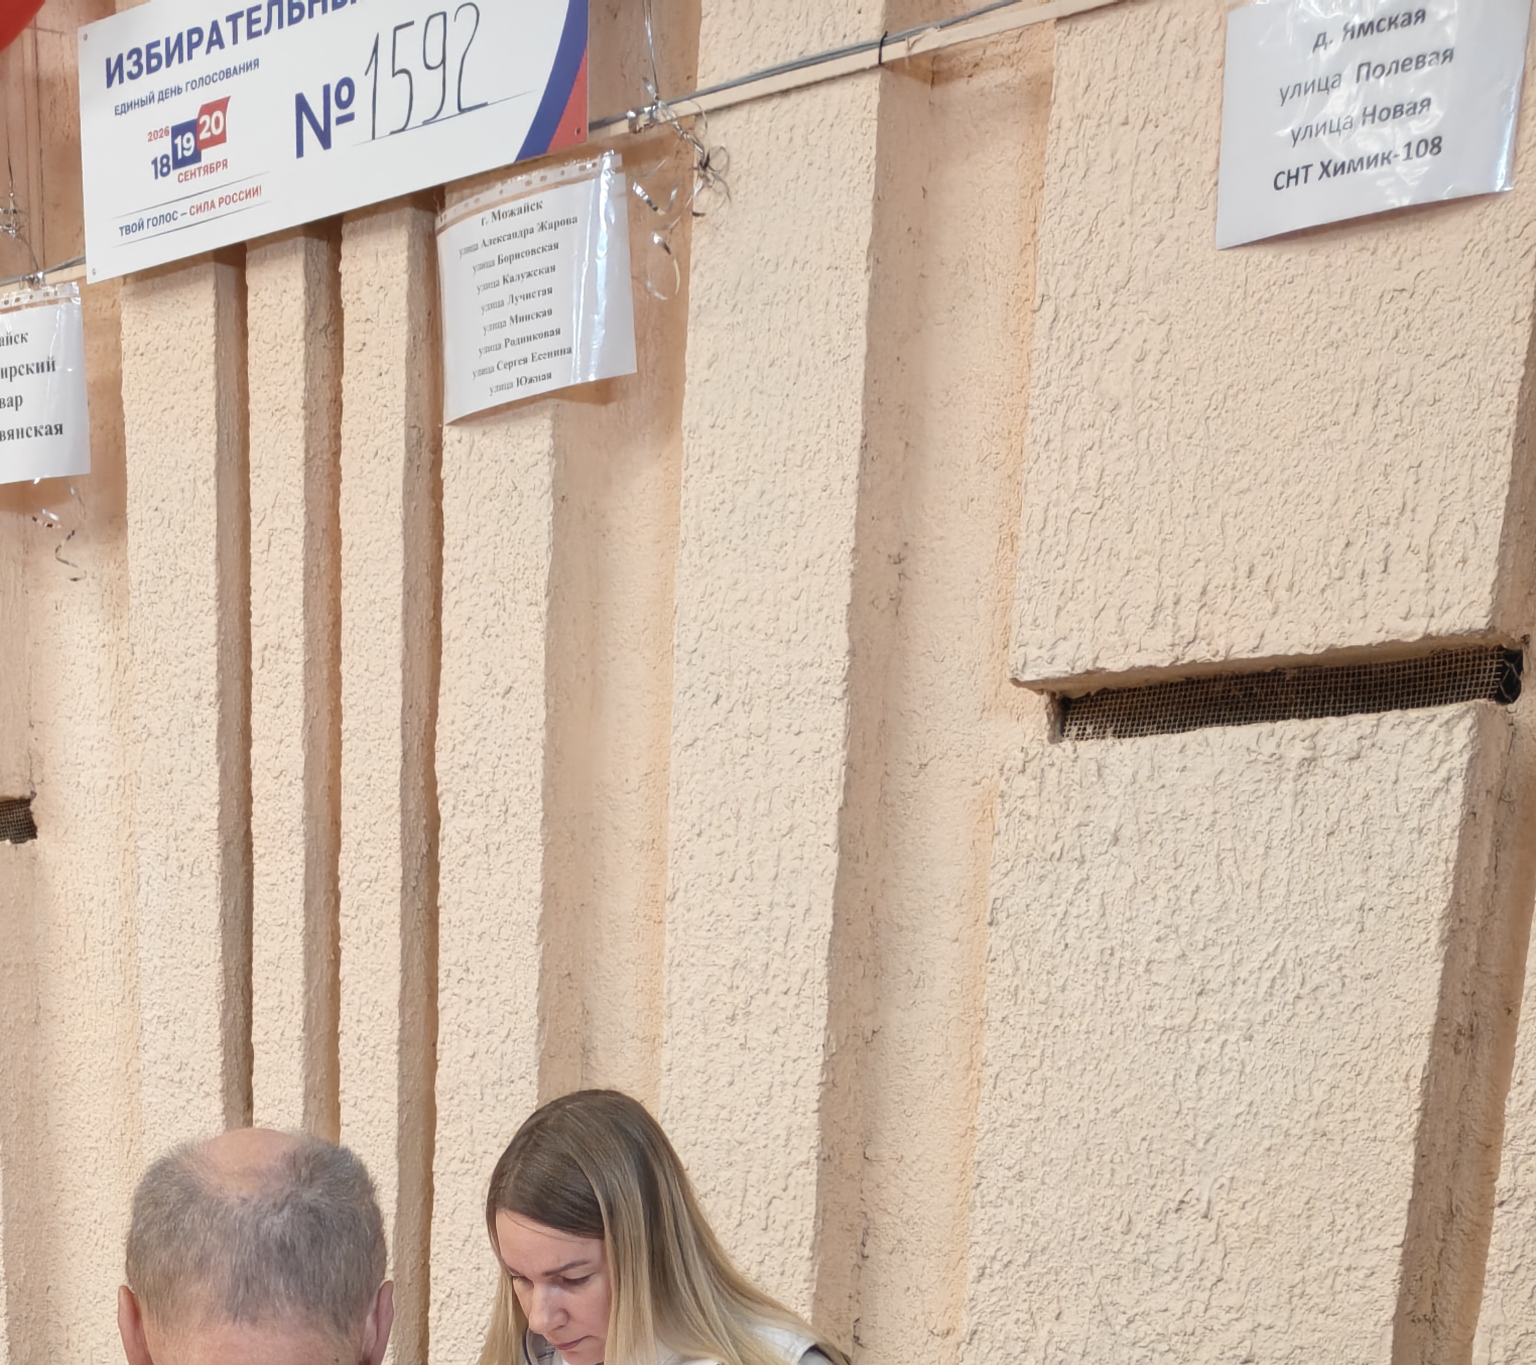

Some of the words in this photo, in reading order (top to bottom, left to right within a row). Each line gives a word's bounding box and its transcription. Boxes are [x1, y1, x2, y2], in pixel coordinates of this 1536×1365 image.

[1342, 8, 1427, 43] Ямская
[114, 91, 155, 117] ЕДИНЫЙ
[157, 84, 183, 104] ДЕНЬ
[185, 58, 260, 93] ГОЛОСОВАНИЯ
[295, 76, 356, 159] №
[364, 4, 489, 141] 1592
[1279, 72, 1342, 107] улица
[1355, 47, 1455, 84] Полевая
[147, 126, 170, 143] 2026
[1290, 114, 1354, 148] улица
[1361, 97, 1433, 127] Новая
[150, 153, 171, 180] 18
[173, 131, 195, 160] 19
[199, 110, 225, 141] 20
[177, 158, 228, 184] СЕНТЯБРЯ
[1273, 163, 1314, 191] СНТ
[1318, 136, 1443, 182] Химик-108
[118, 218, 144, 237] ТВОЙ
[146, 210, 178, 229] ГОЛОС
[189, 199, 216, 216] СИЛА
[218, 184, 262, 208] РОССИИ!
[491, 200, 544, 224] Можайск
[480, 225, 534, 248] Александра
[536, 215, 578, 233] Жарова
[497, 241, 560, 266] Борисовская
[502, 264, 556, 286] Калужская
[507, 286, 553, 307] Лучистая
[509, 307, 553, 327] Минская
[504, 326, 562, 350] Родниковая
[496, 354, 528, 374] Сергея
[515, 371, 552, 389] Южная
